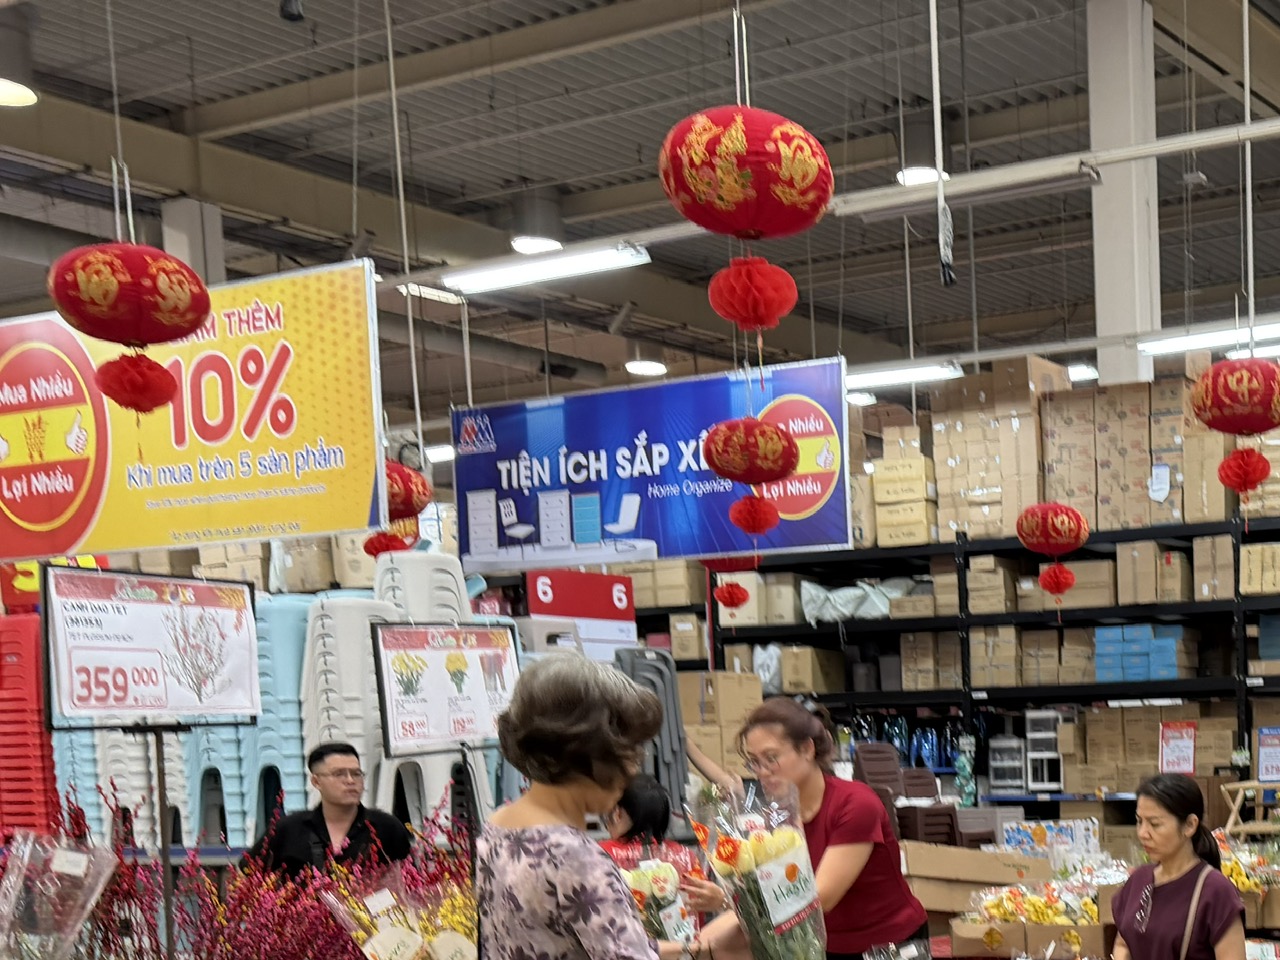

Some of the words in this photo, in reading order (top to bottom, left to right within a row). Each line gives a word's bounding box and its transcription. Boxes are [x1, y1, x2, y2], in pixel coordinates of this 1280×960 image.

[165, 340, 296, 446] 10%
[788, 413, 824, 434] Nhiều
[126, 463, 153, 489] Khi
[157, 464, 193, 486] mua
[198, 455, 234, 483] trên
[238, 451, 252, 478] 5
[257, 448, 290, 476] sản
[497, 449, 550, 497] TIỆN
[558, 444, 608, 485] ÍCH
[615, 429, 670, 479] SẮP
[648, 482, 680, 499] Home
[682, 477, 733, 497] Organize
[786, 476, 822, 496] Nhiều
[536, 575, 554, 603] 6
[612, 582, 629, 609] 6
[75, 665, 129, 704] 359
[131, 666, 159, 686] 000
